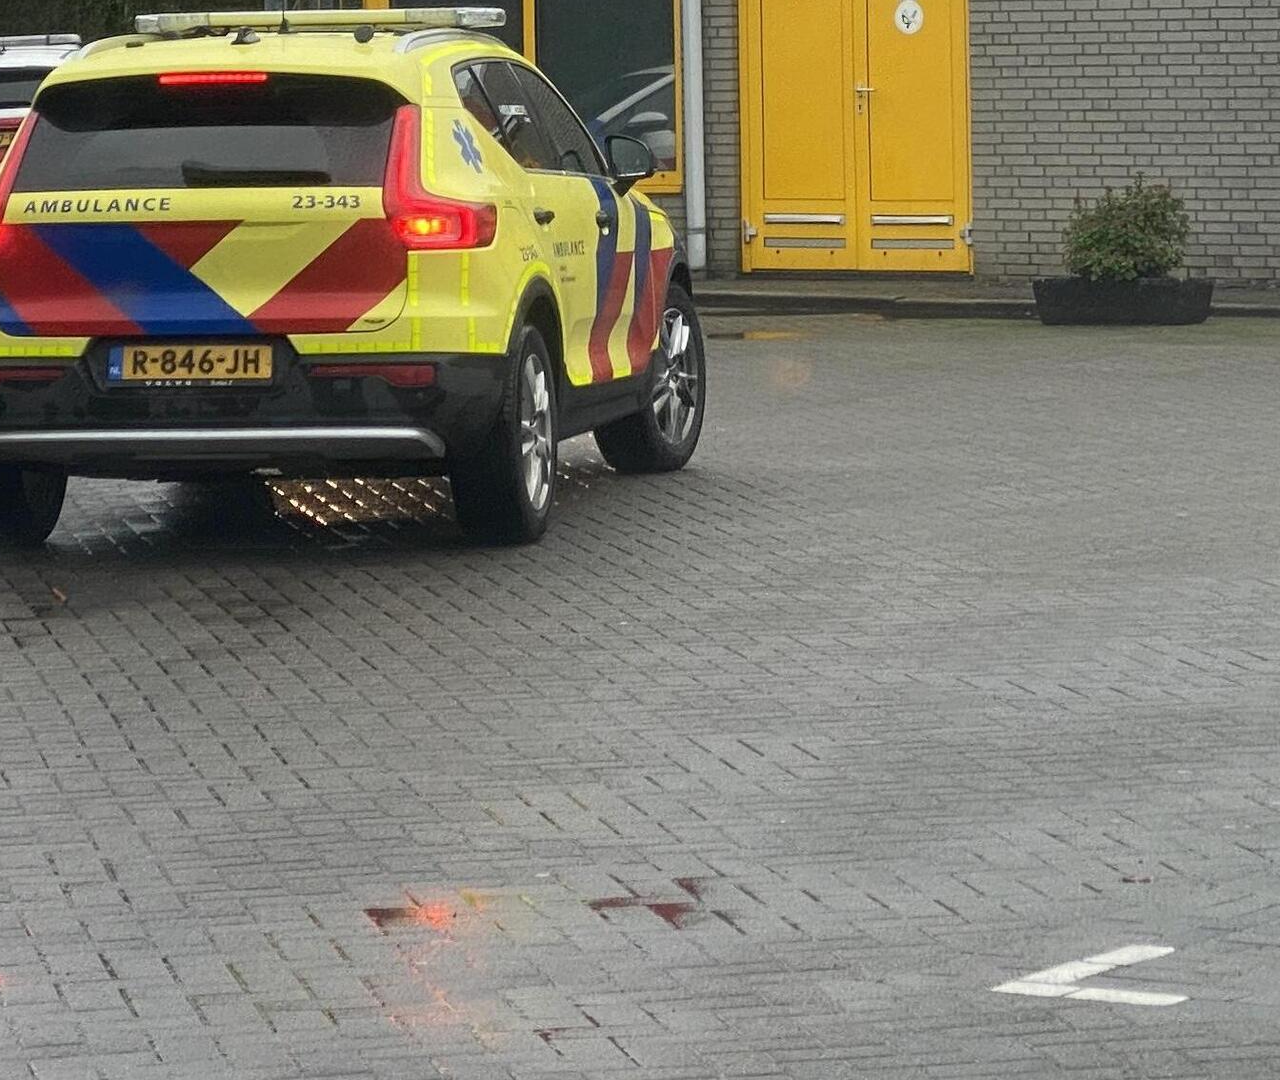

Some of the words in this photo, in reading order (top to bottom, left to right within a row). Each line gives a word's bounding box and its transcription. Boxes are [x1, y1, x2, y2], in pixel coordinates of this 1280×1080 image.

[23, 197, 171, 214] AMBULANCE
[292, 195, 361, 209] 23-343
[109, 366, 121, 375] NL
[132, 349, 260, 375] R-846-JH
